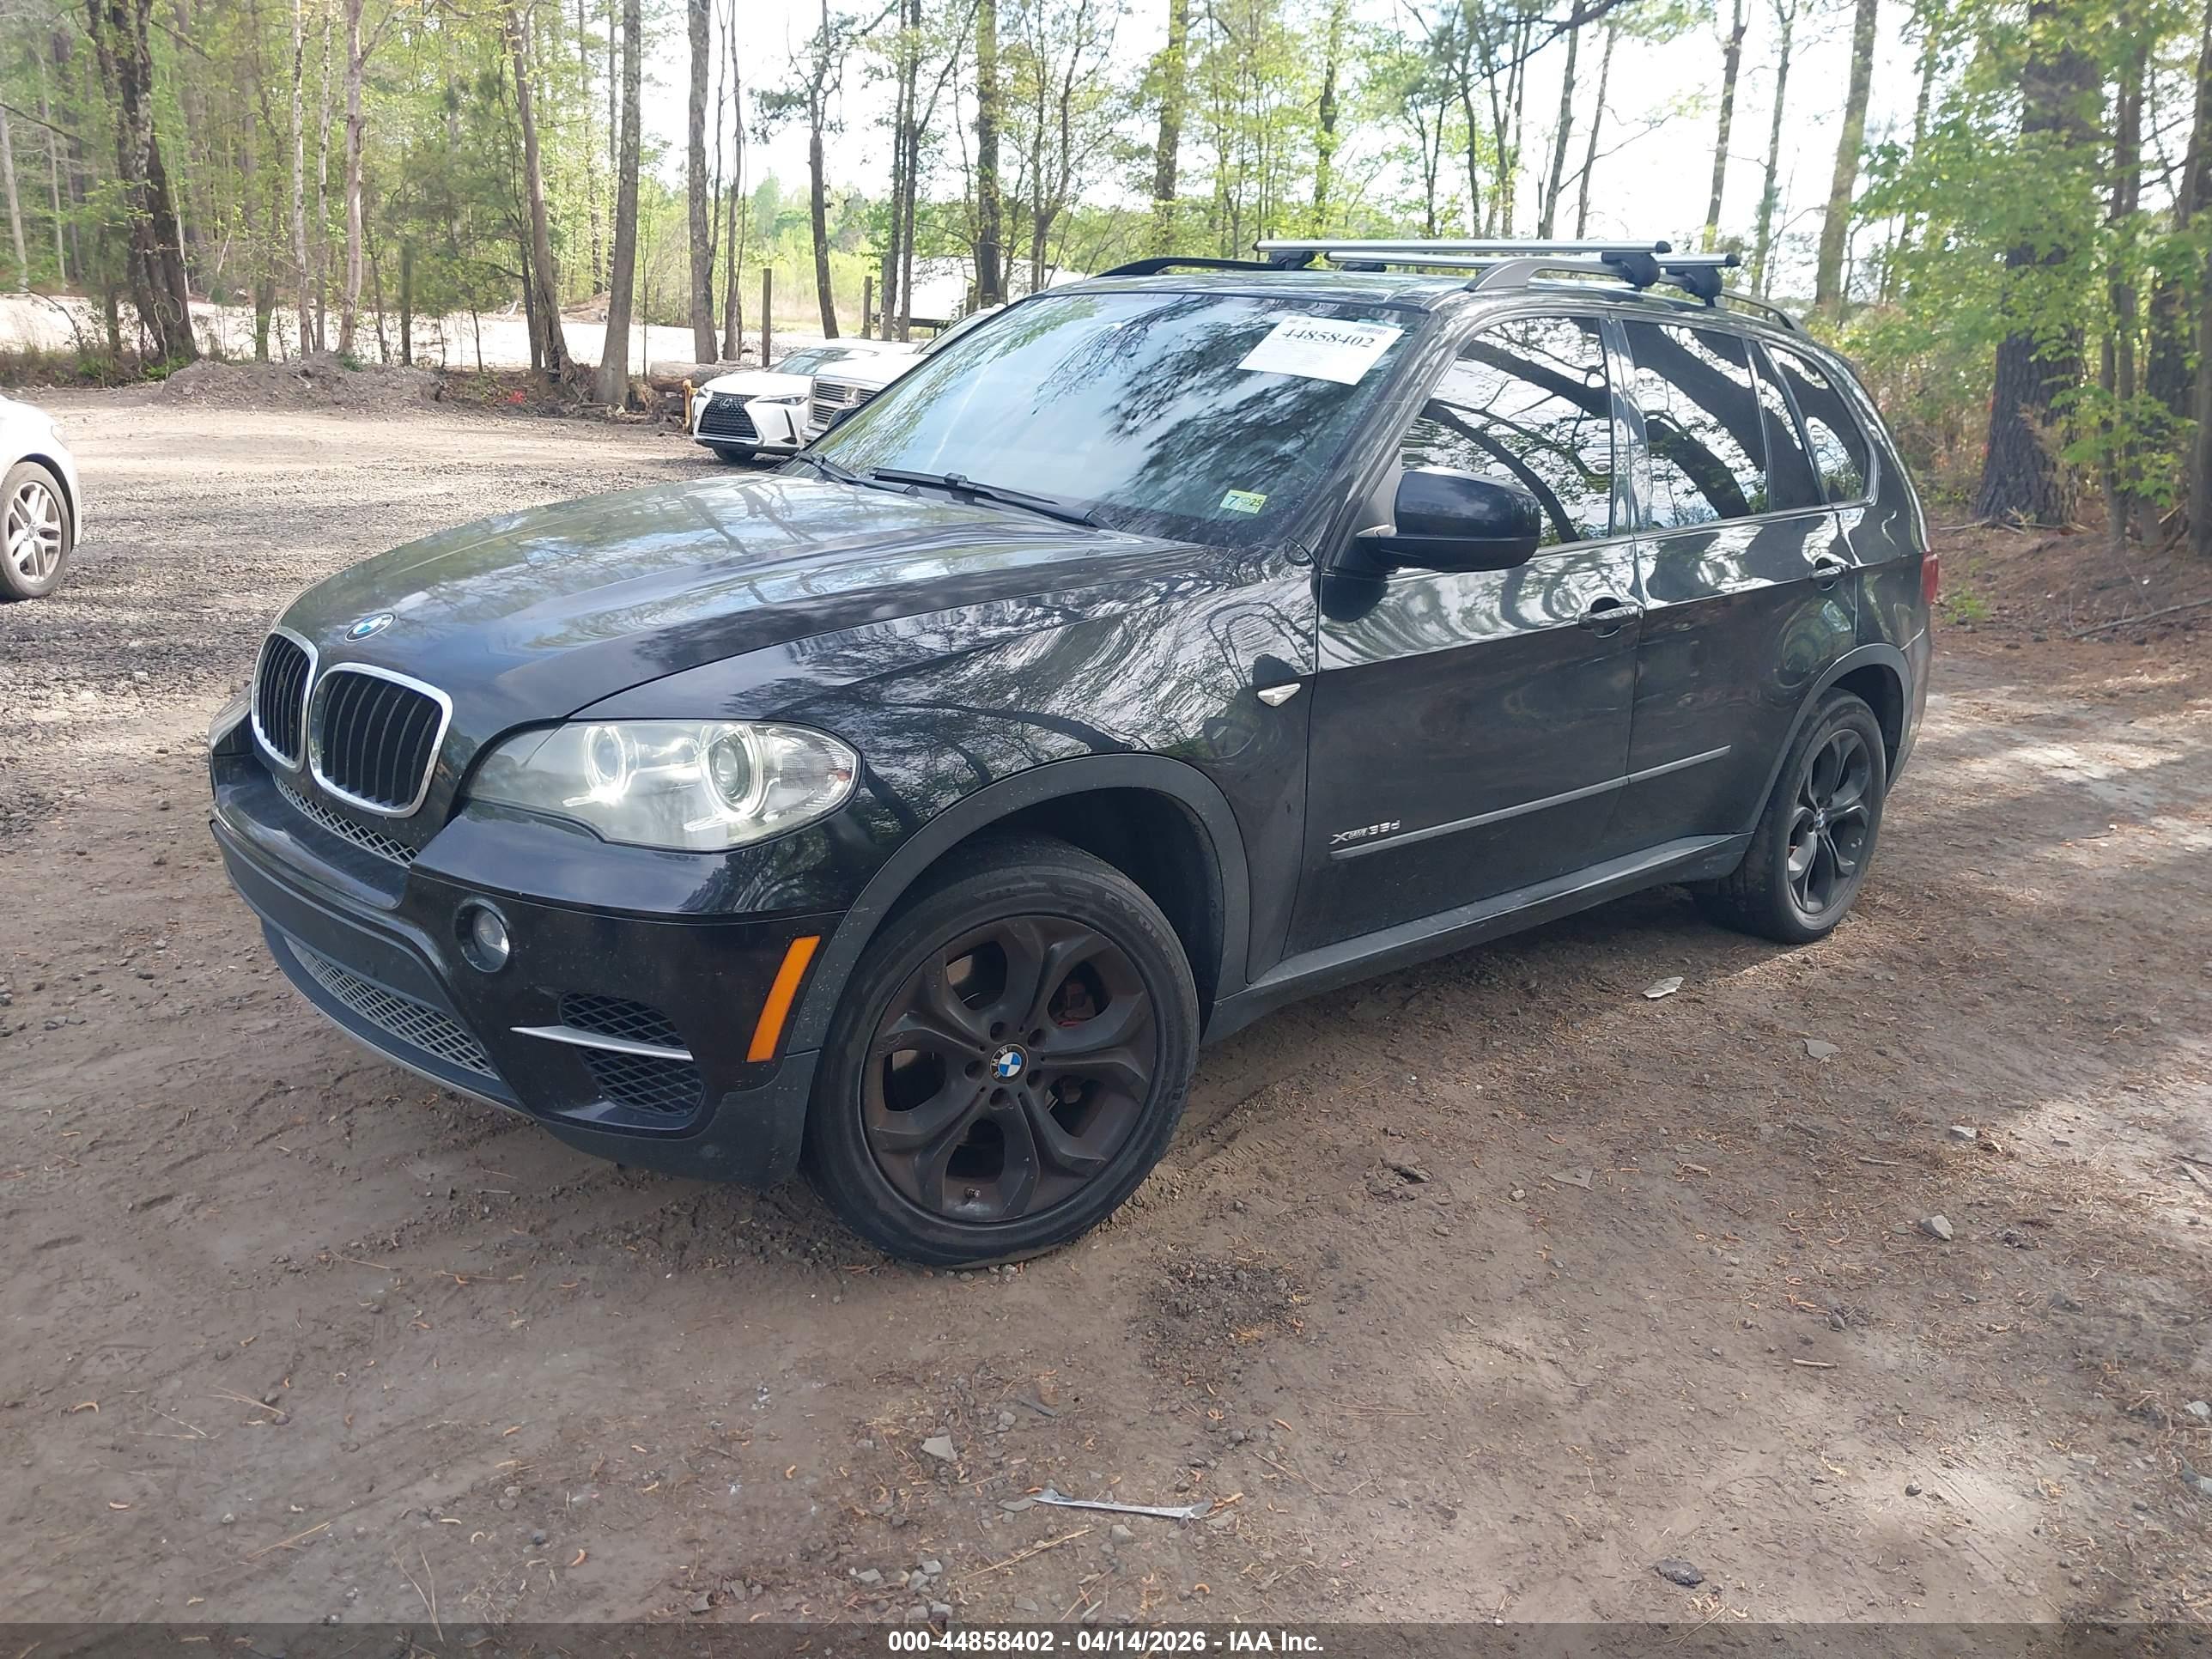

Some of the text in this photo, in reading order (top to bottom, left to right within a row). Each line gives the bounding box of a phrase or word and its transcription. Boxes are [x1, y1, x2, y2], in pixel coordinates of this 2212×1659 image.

[1281, 327, 1376, 348] 44858402
[1228, 495, 1263, 507] 7 25
[991, 1046, 1008, 1079] BMW
